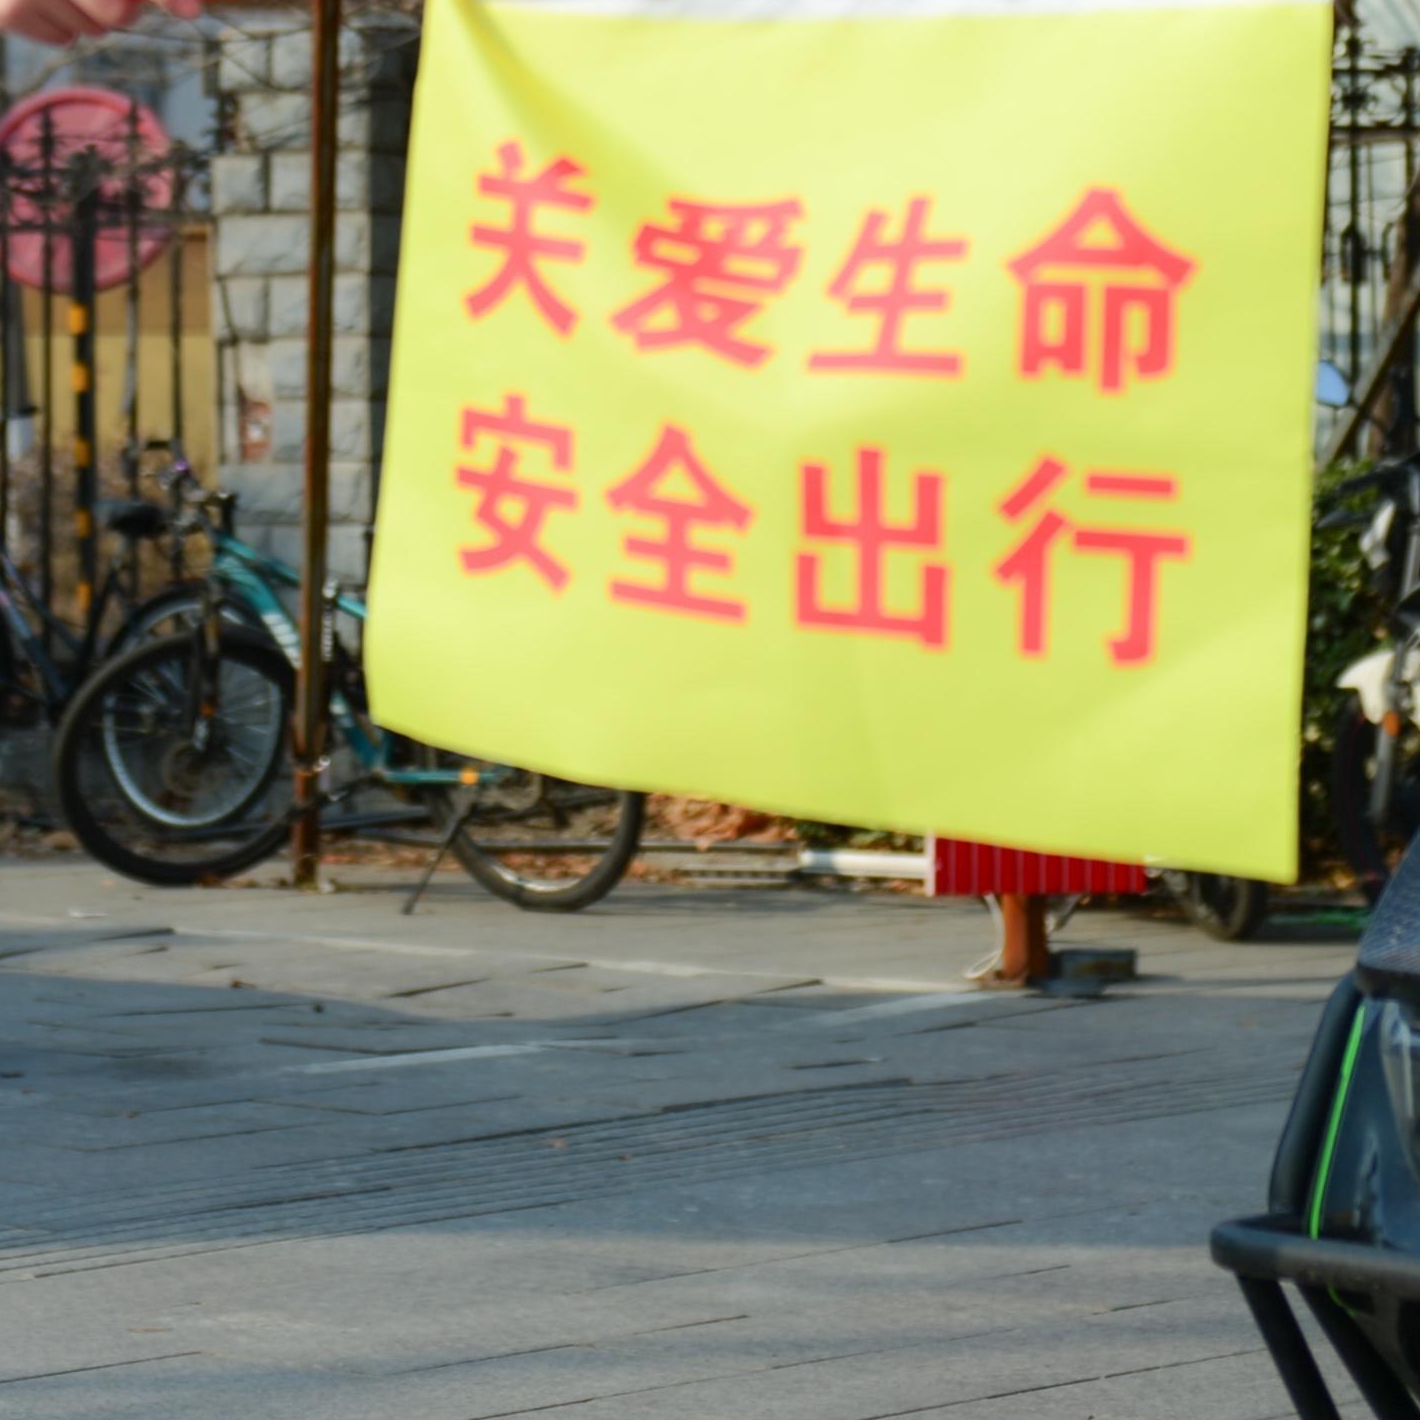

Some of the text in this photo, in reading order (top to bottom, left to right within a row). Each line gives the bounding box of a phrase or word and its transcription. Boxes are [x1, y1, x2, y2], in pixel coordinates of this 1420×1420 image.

[462, 140, 1200, 397] 关爱生命
[453, 392, 1194, 669] 安全出行
